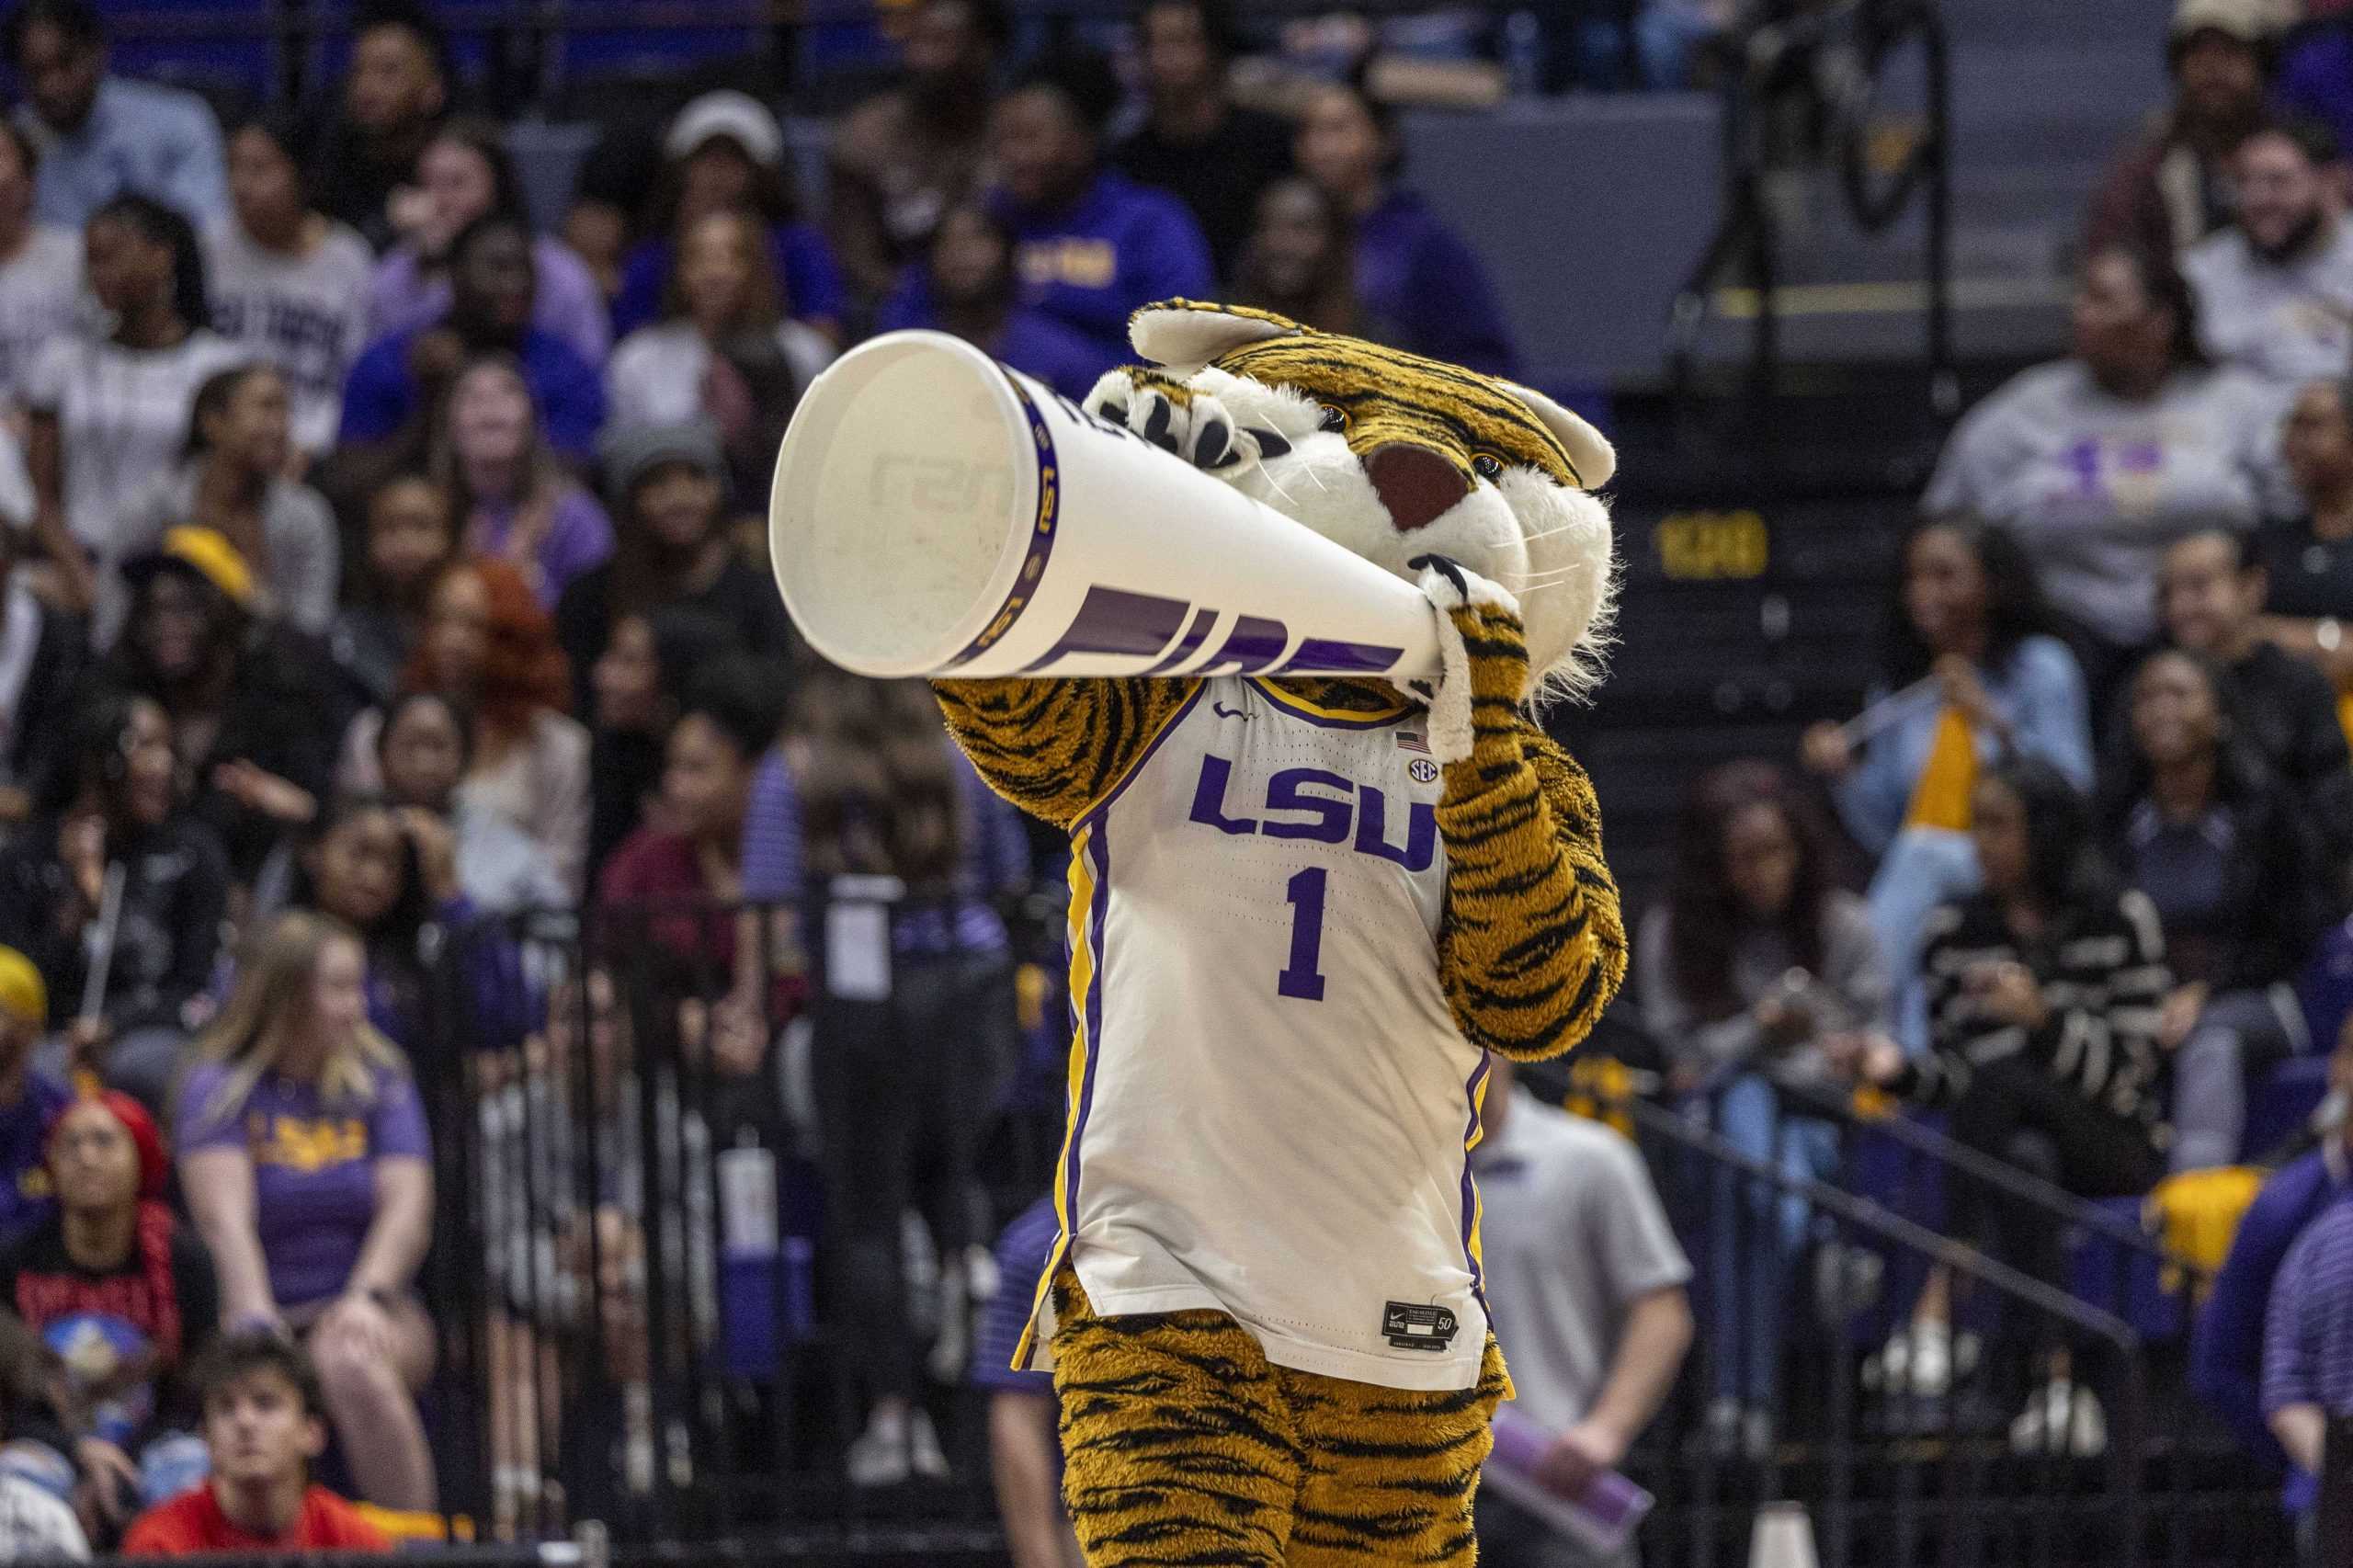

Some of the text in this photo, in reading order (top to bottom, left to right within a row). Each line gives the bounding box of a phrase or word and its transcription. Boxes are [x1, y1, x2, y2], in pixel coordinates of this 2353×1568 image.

[1410, 759, 1438, 783] SEC
[1189, 753, 1436, 872] LSU
[1278, 866, 1328, 1001] 1
[1438, 1317, 1452, 1330] 50
